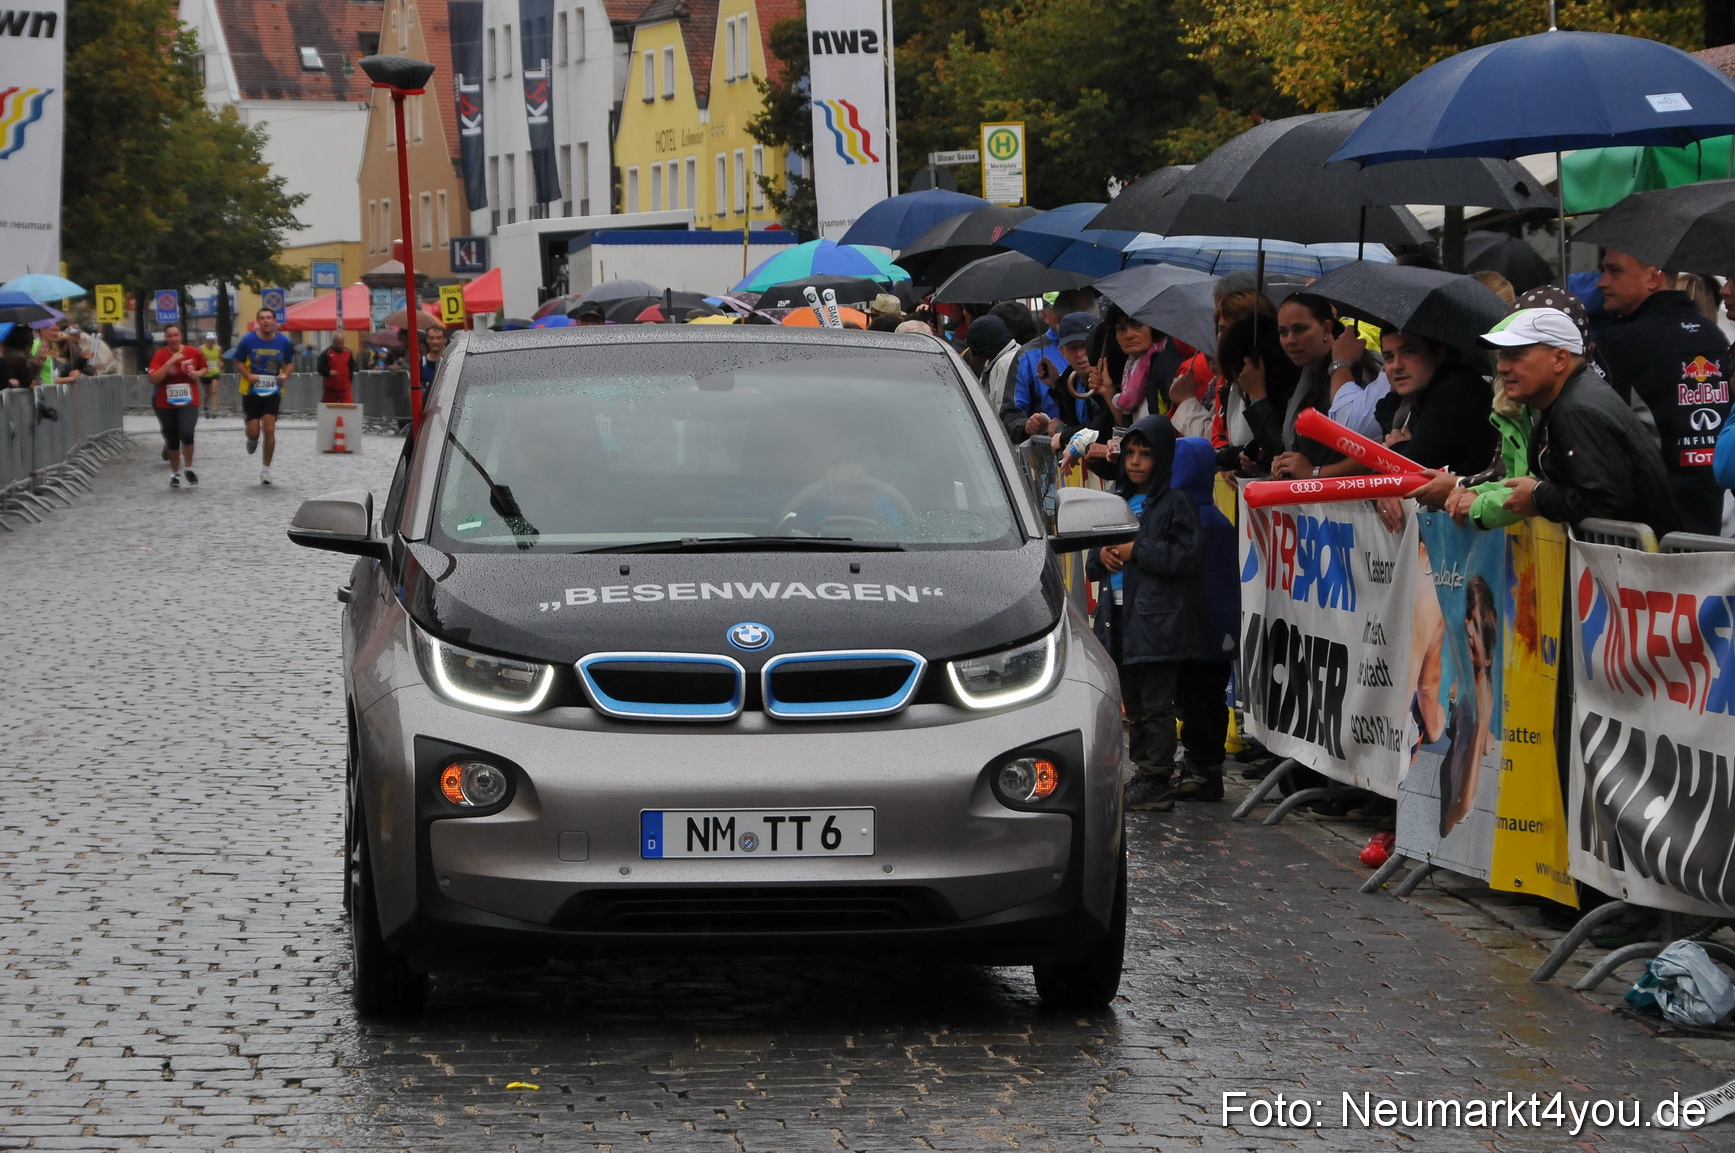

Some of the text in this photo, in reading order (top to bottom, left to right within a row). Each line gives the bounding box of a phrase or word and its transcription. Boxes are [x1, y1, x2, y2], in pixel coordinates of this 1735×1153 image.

[655, 128, 677, 153] HOTEL
[995, 136, 1011, 153] H
[937, 152, 976, 162] Ulmer Gasse
[98, 286, 119, 294] Block
[442, 287, 462, 295] Block
[103, 296, 117, 315] D
[446, 296, 460, 315] D
[158, 311, 177, 320] TAXI
[256, 380, 275, 389] 2384
[168, 388, 189, 398] 2306
[1336, 476, 1403, 491] Audi BKK
[686, 815, 842, 852] NM TT 6
[647, 839, 656, 850] D
